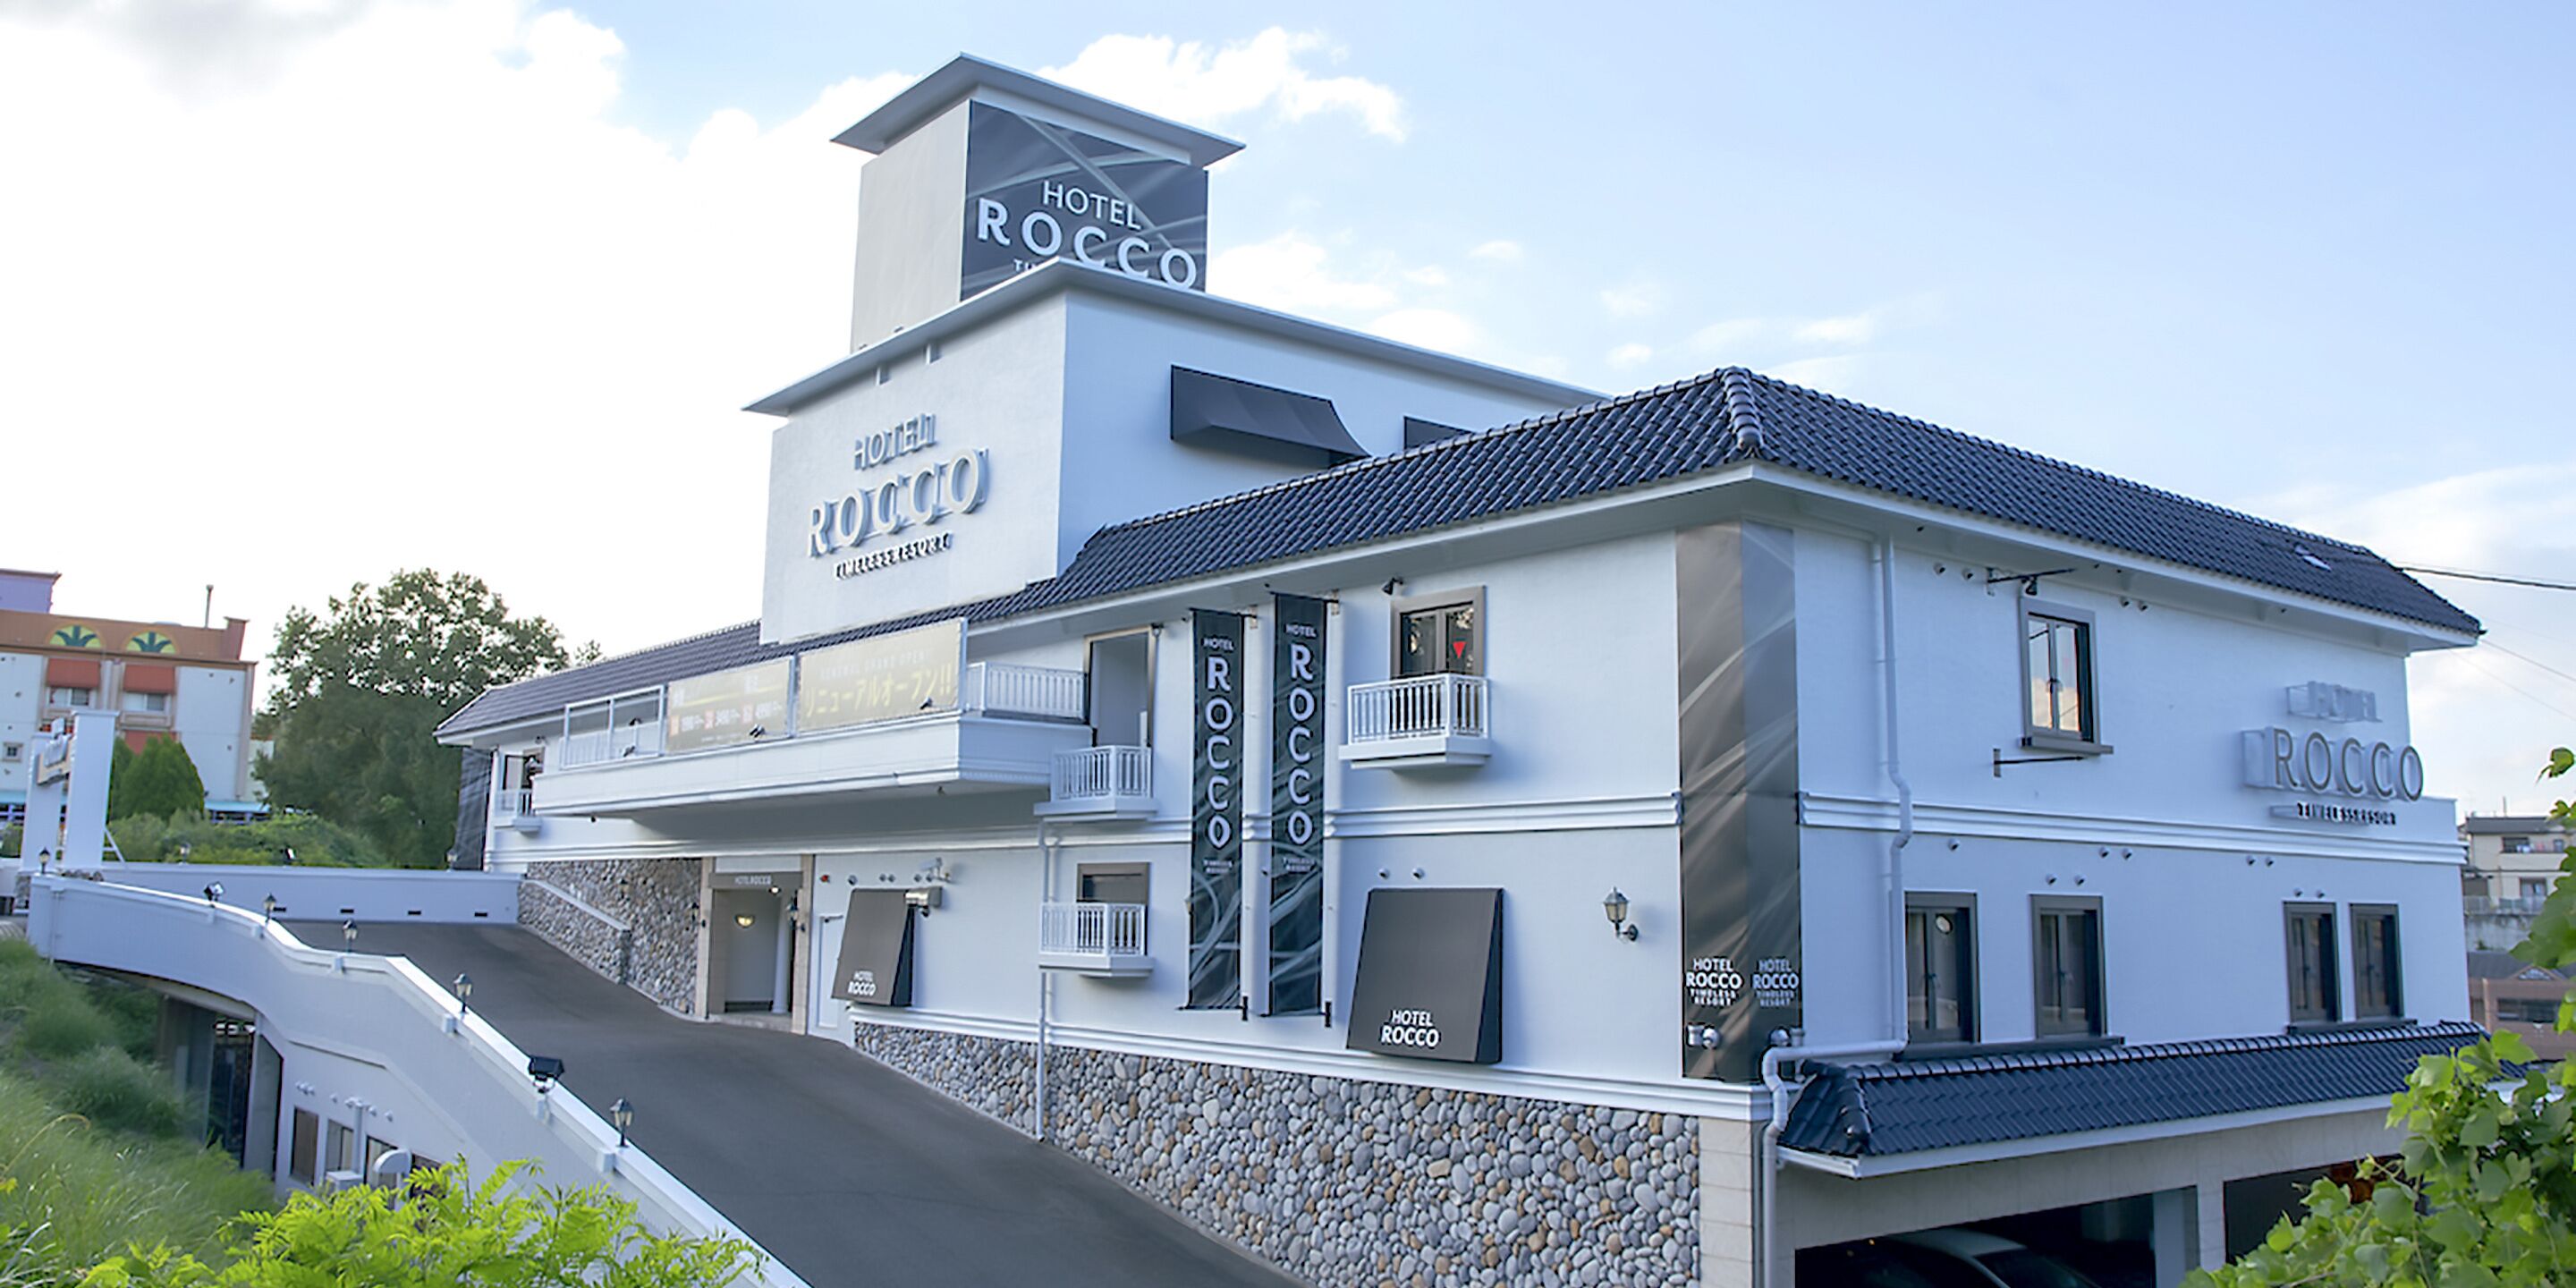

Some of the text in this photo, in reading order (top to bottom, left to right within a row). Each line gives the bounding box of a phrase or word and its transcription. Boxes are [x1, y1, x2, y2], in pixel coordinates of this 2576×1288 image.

[1042, 180, 1141, 230] HOTEL
[977, 198, 1197, 290] ROCCO
[854, 413, 936, 470] HOTEL
[809, 448, 987, 558] ROCCO
[1285, 623, 1317, 638] HOTEL
[1203, 637, 1234, 651] HOTEL
[1206, 656, 1233, 849] ROCCO
[1287, 643, 1315, 844] ROCCO
[2272, 727, 2424, 801] ROCCO
[1693, 958, 1734, 972] HOTEL
[1758, 958, 1792, 973] HOTEL
[848, 980, 877, 996] ROCCO
[1686, 972, 1742, 989] ROCCO
[1752, 973, 1800, 989] ROCCO
[1392, 1010, 1434, 1027] HOTEL
[1381, 1025, 1440, 1047] ROCCO
